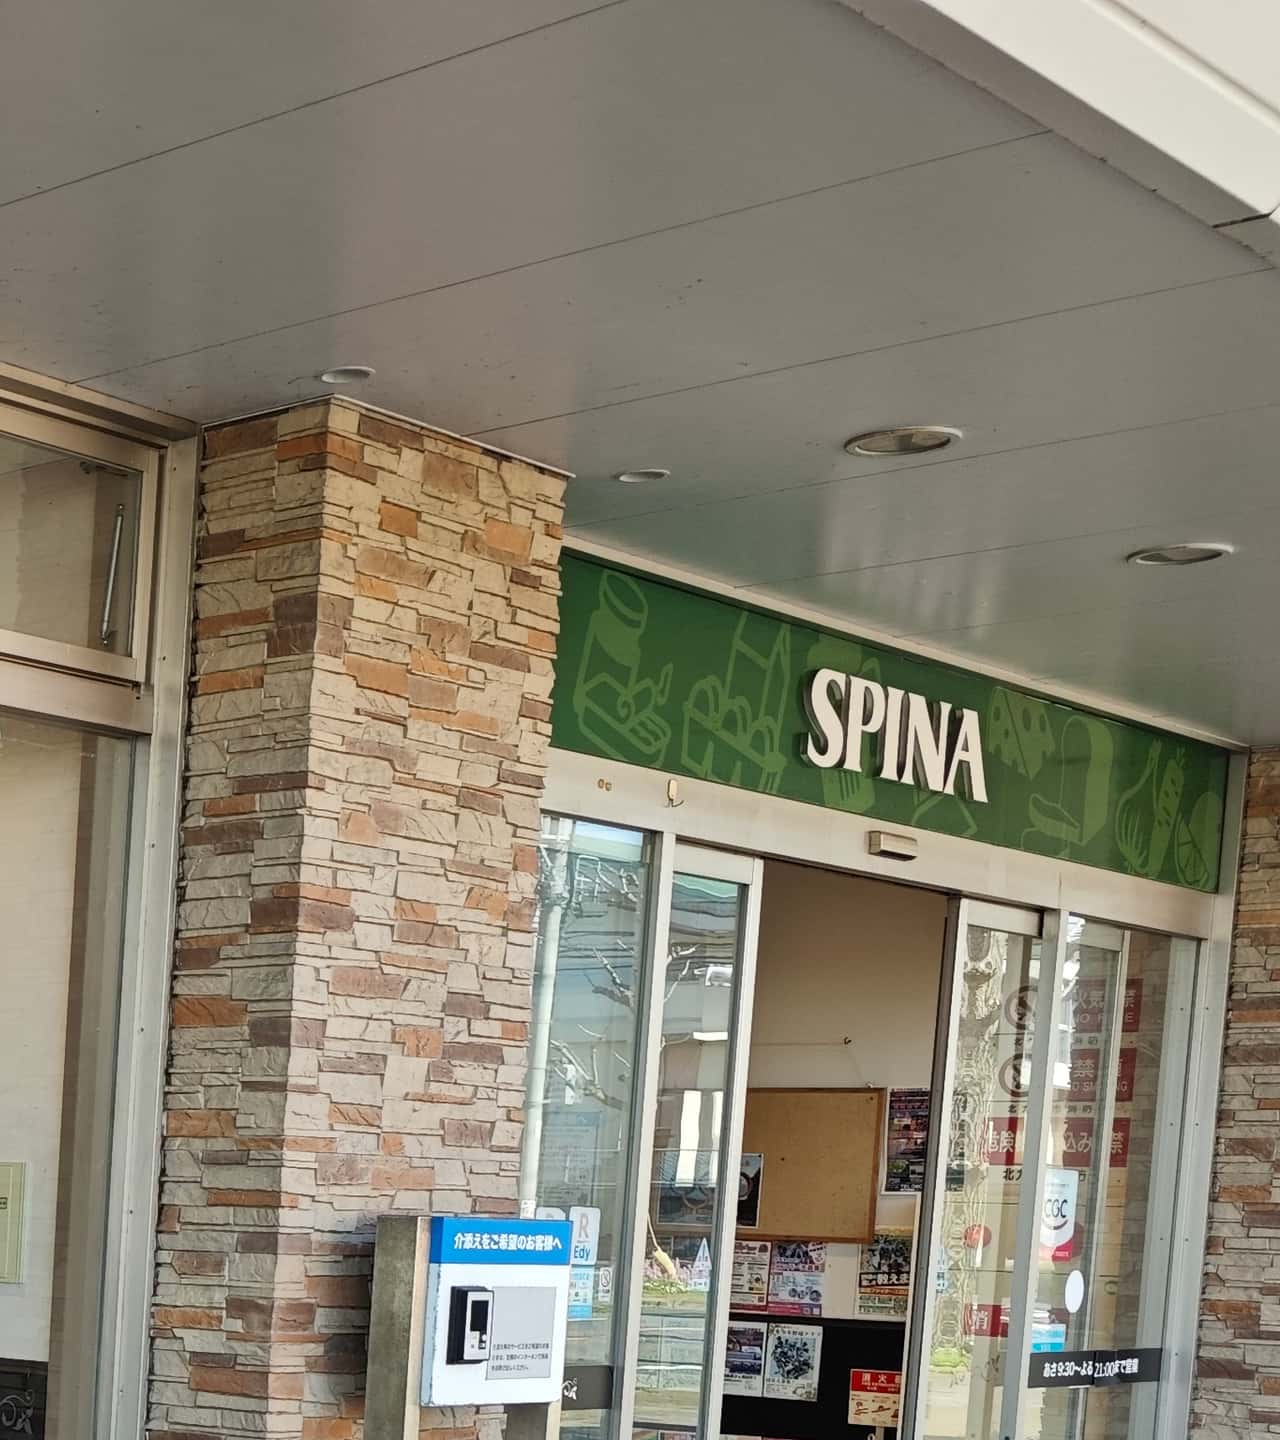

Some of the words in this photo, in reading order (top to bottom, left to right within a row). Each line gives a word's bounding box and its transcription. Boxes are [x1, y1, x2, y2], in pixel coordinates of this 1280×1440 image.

[804, 668, 989, 804] SPINA
[1044, 1198, 1068, 1219] CGC
[453, 1231, 563, 1251] 介添えをご希望のお客様へ
[573, 1244, 592, 1262] Edy
